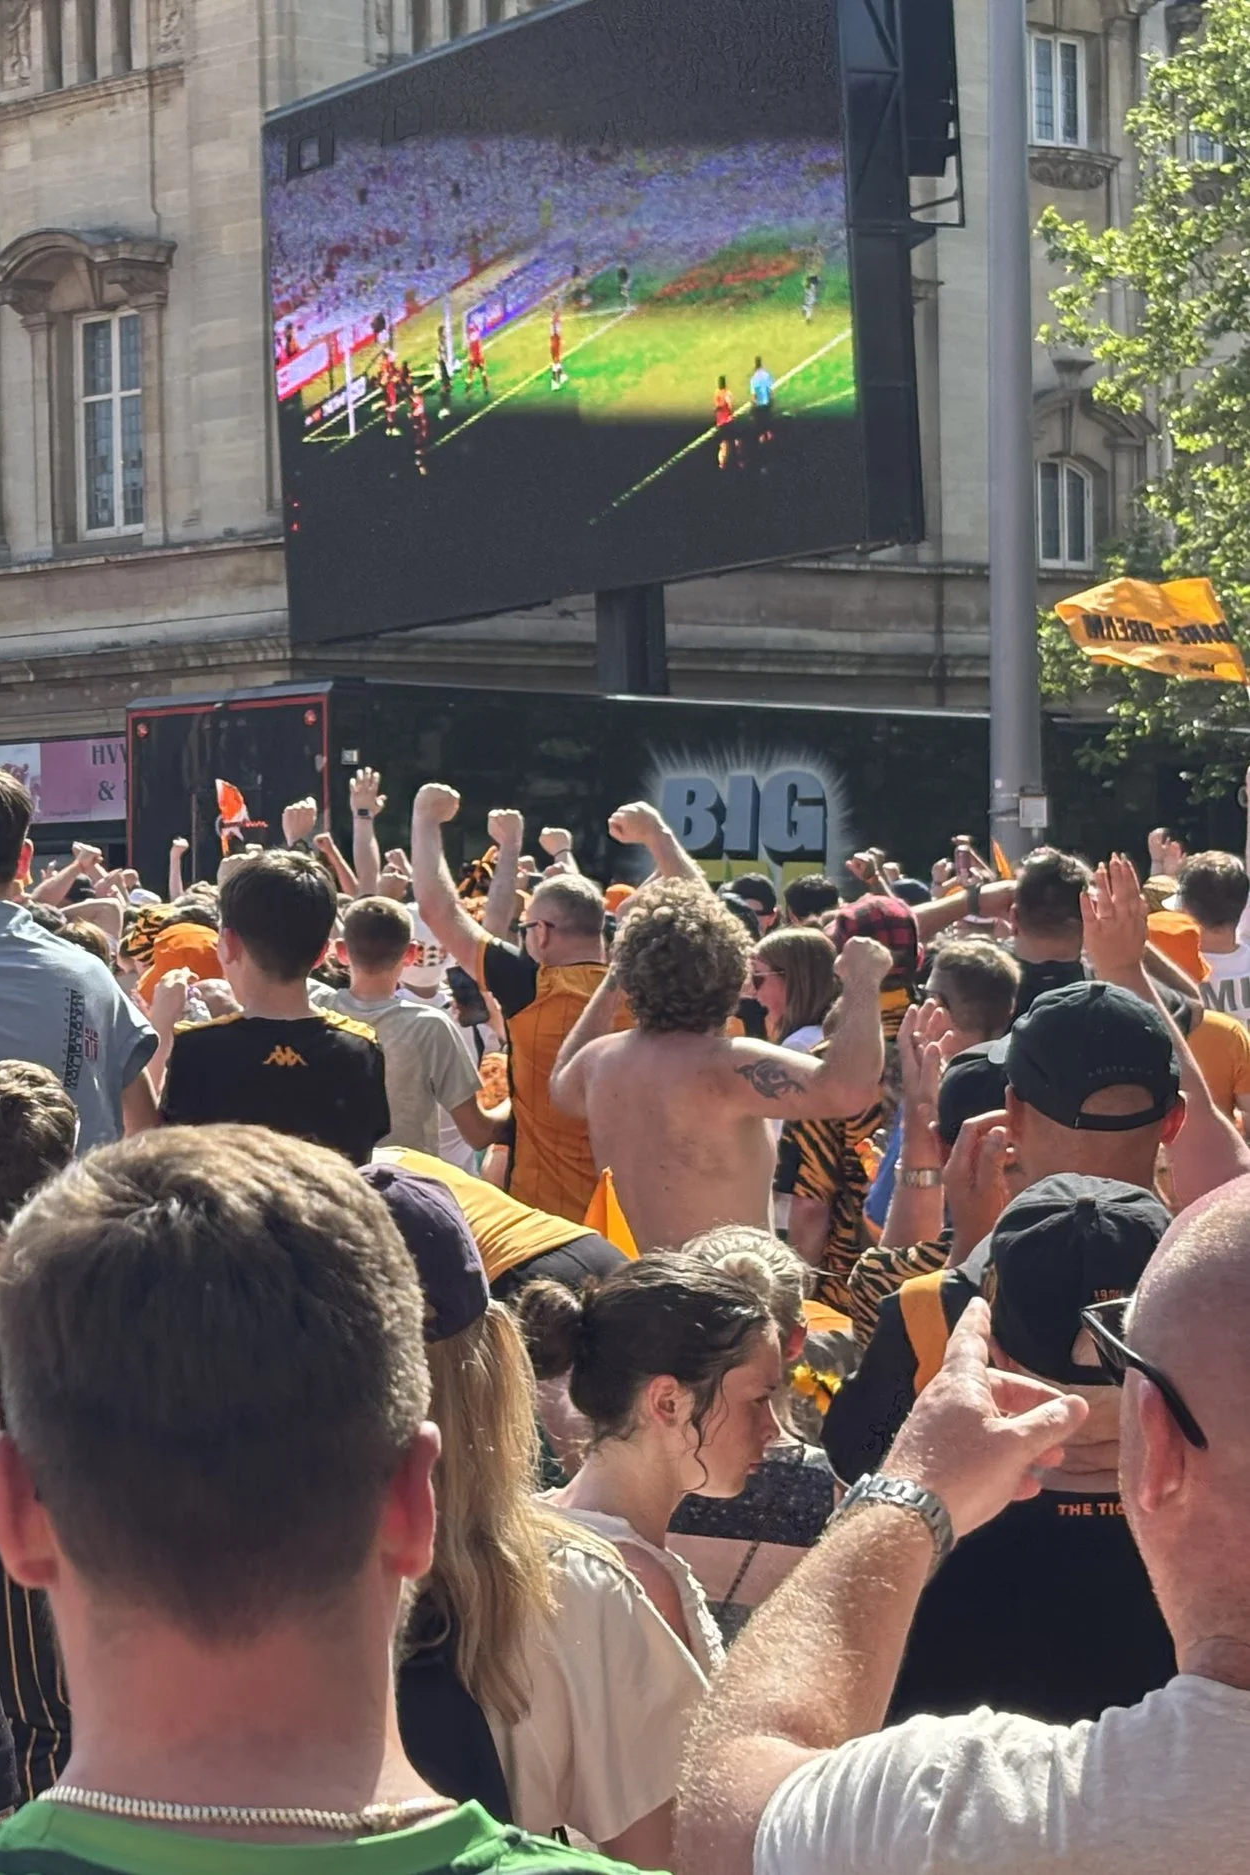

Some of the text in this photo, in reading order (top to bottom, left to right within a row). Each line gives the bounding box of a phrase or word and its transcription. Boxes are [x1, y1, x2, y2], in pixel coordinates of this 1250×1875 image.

[98, 780, 116, 801] &
[662, 770, 828, 860] BIG
[1057, 1503, 1093, 1516] THE
